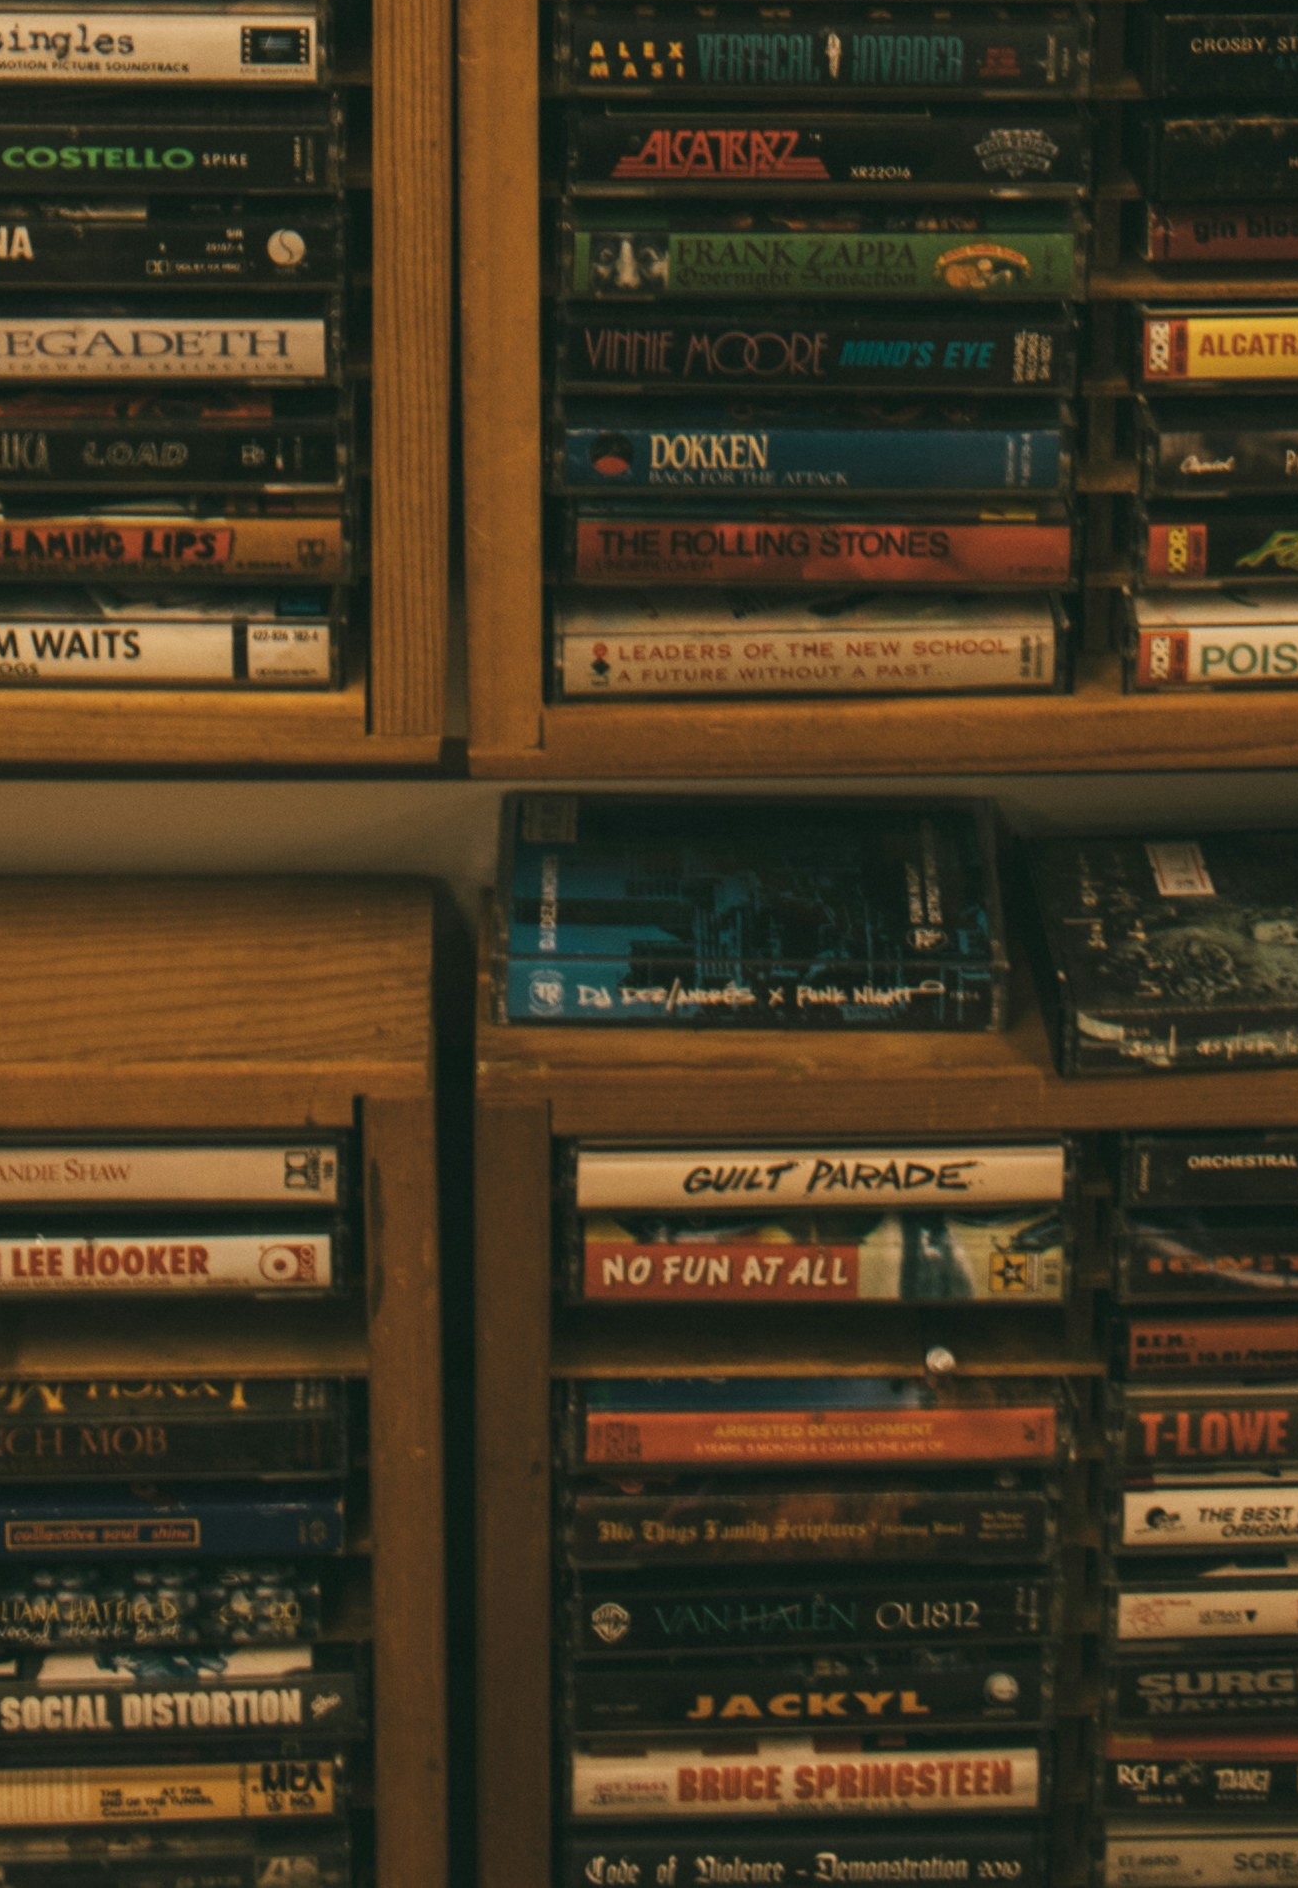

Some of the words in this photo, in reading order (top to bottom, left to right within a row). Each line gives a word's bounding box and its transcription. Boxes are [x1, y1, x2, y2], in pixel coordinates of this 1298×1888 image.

[3, 147, 194, 169] COSTELLO
[34, 629, 140, 660] WAITS
[10, 1247, 63, 1278] LEE
[73, 1244, 209, 1278] HOOKER
[603, 1255, 651, 1285] NO
[662, 1255, 730, 1286] FUN
[742, 1255, 783, 1285] AT
[789, 1255, 849, 1285] ALL
[686, 1692, 931, 1720] JACKYL
[677, 1768, 783, 1801] BRUCE
[794, 1760, 1013, 1798] SPRINGSTEEN
